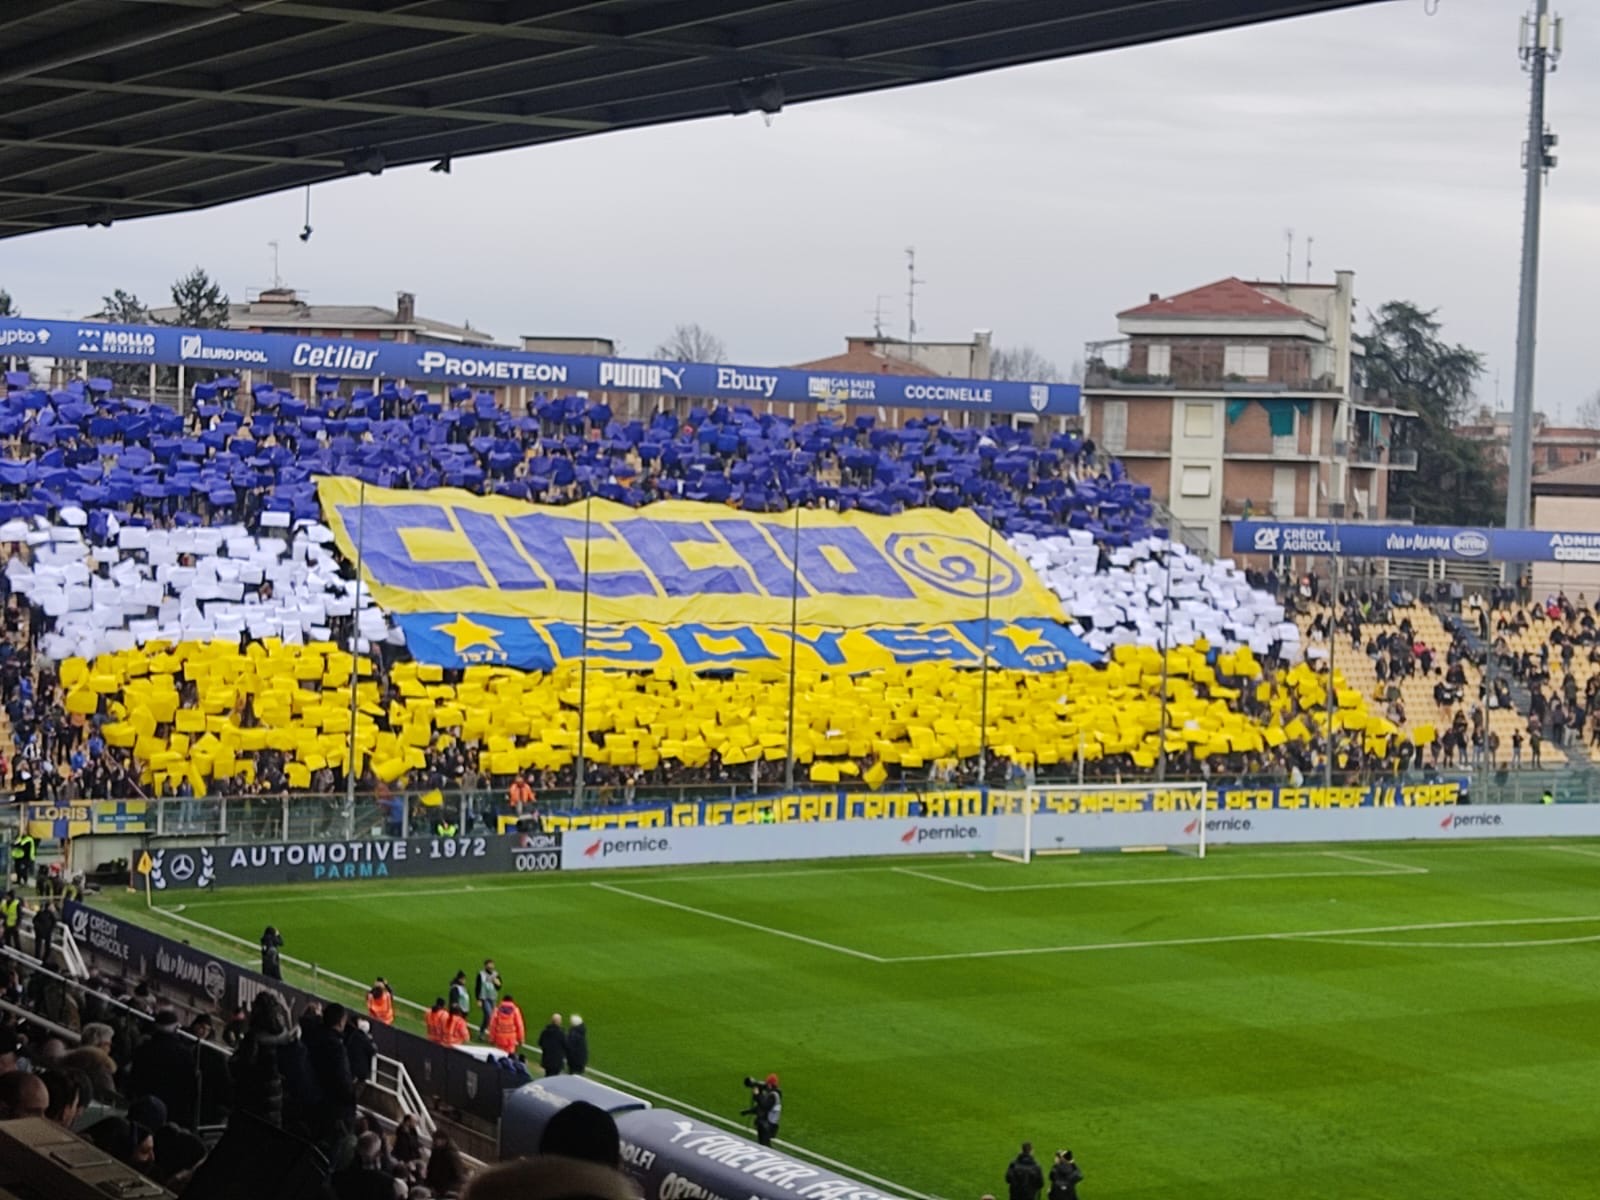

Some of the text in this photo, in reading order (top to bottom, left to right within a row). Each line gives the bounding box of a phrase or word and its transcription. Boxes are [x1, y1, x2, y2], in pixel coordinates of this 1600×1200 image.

[103, 330, 155, 347] MOLLO
[293, 343, 379, 370] Cetilar
[417, 351, 568, 382] PROMETEON
[600, 362, 664, 389] PUMA
[717, 368, 778, 397] Ebury
[904, 385, 992, 403] COCCINELLE
[335, 503, 918, 600] CICCIO
[1283, 540, 1341, 553] AGRICOLE
[543, 620, 981, 665] BOYS
[36, 806, 88, 821] LORIS
[231, 838, 487, 867] AUTOMOTIVE 1972
[516, 852, 558, 871] 00:00
[314, 862, 390, 880] PARMA
